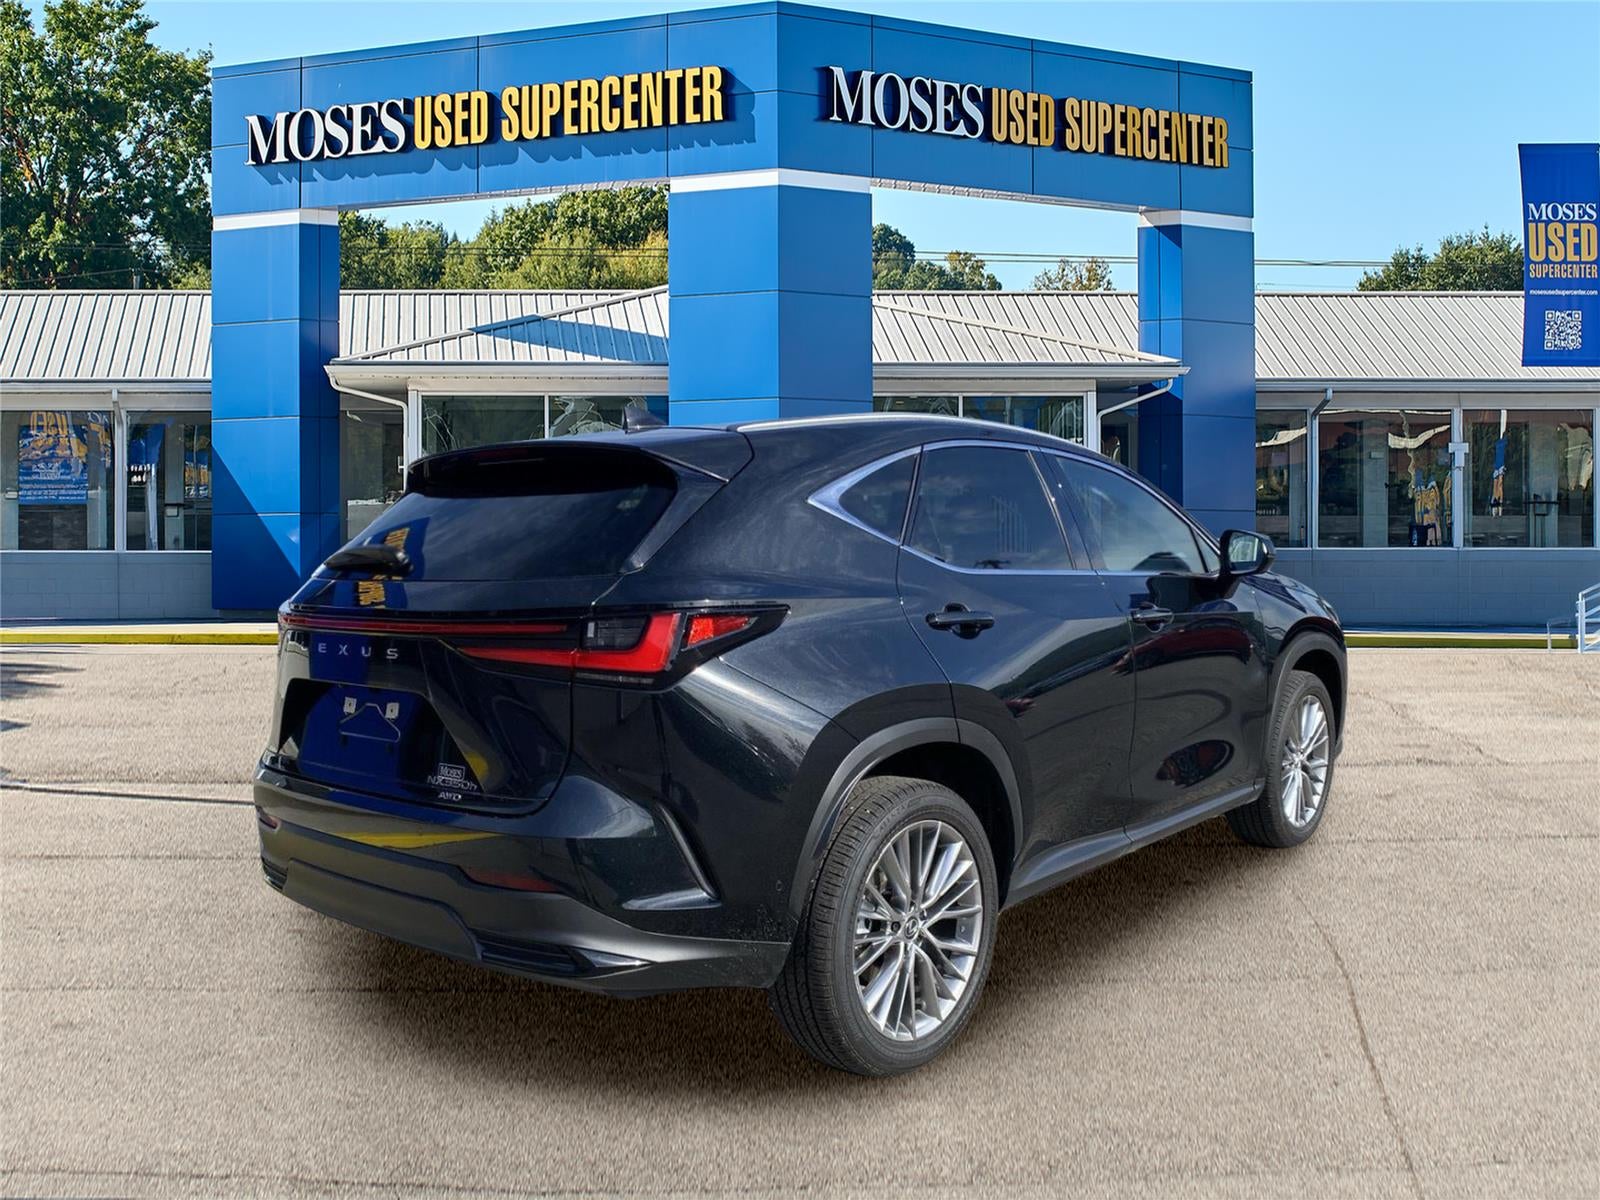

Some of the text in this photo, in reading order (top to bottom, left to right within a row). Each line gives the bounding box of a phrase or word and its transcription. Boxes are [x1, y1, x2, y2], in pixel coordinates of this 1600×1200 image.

[244, 65, 724, 166] MOSES USED SUPERCENTER
[829, 65, 1229, 168] MOSES USED SUPERCENTER
[1528, 203, 1597, 221] MOSES
[1528, 222, 1598, 262] USED
[1529, 263, 1598, 279] SUPERCENTER
